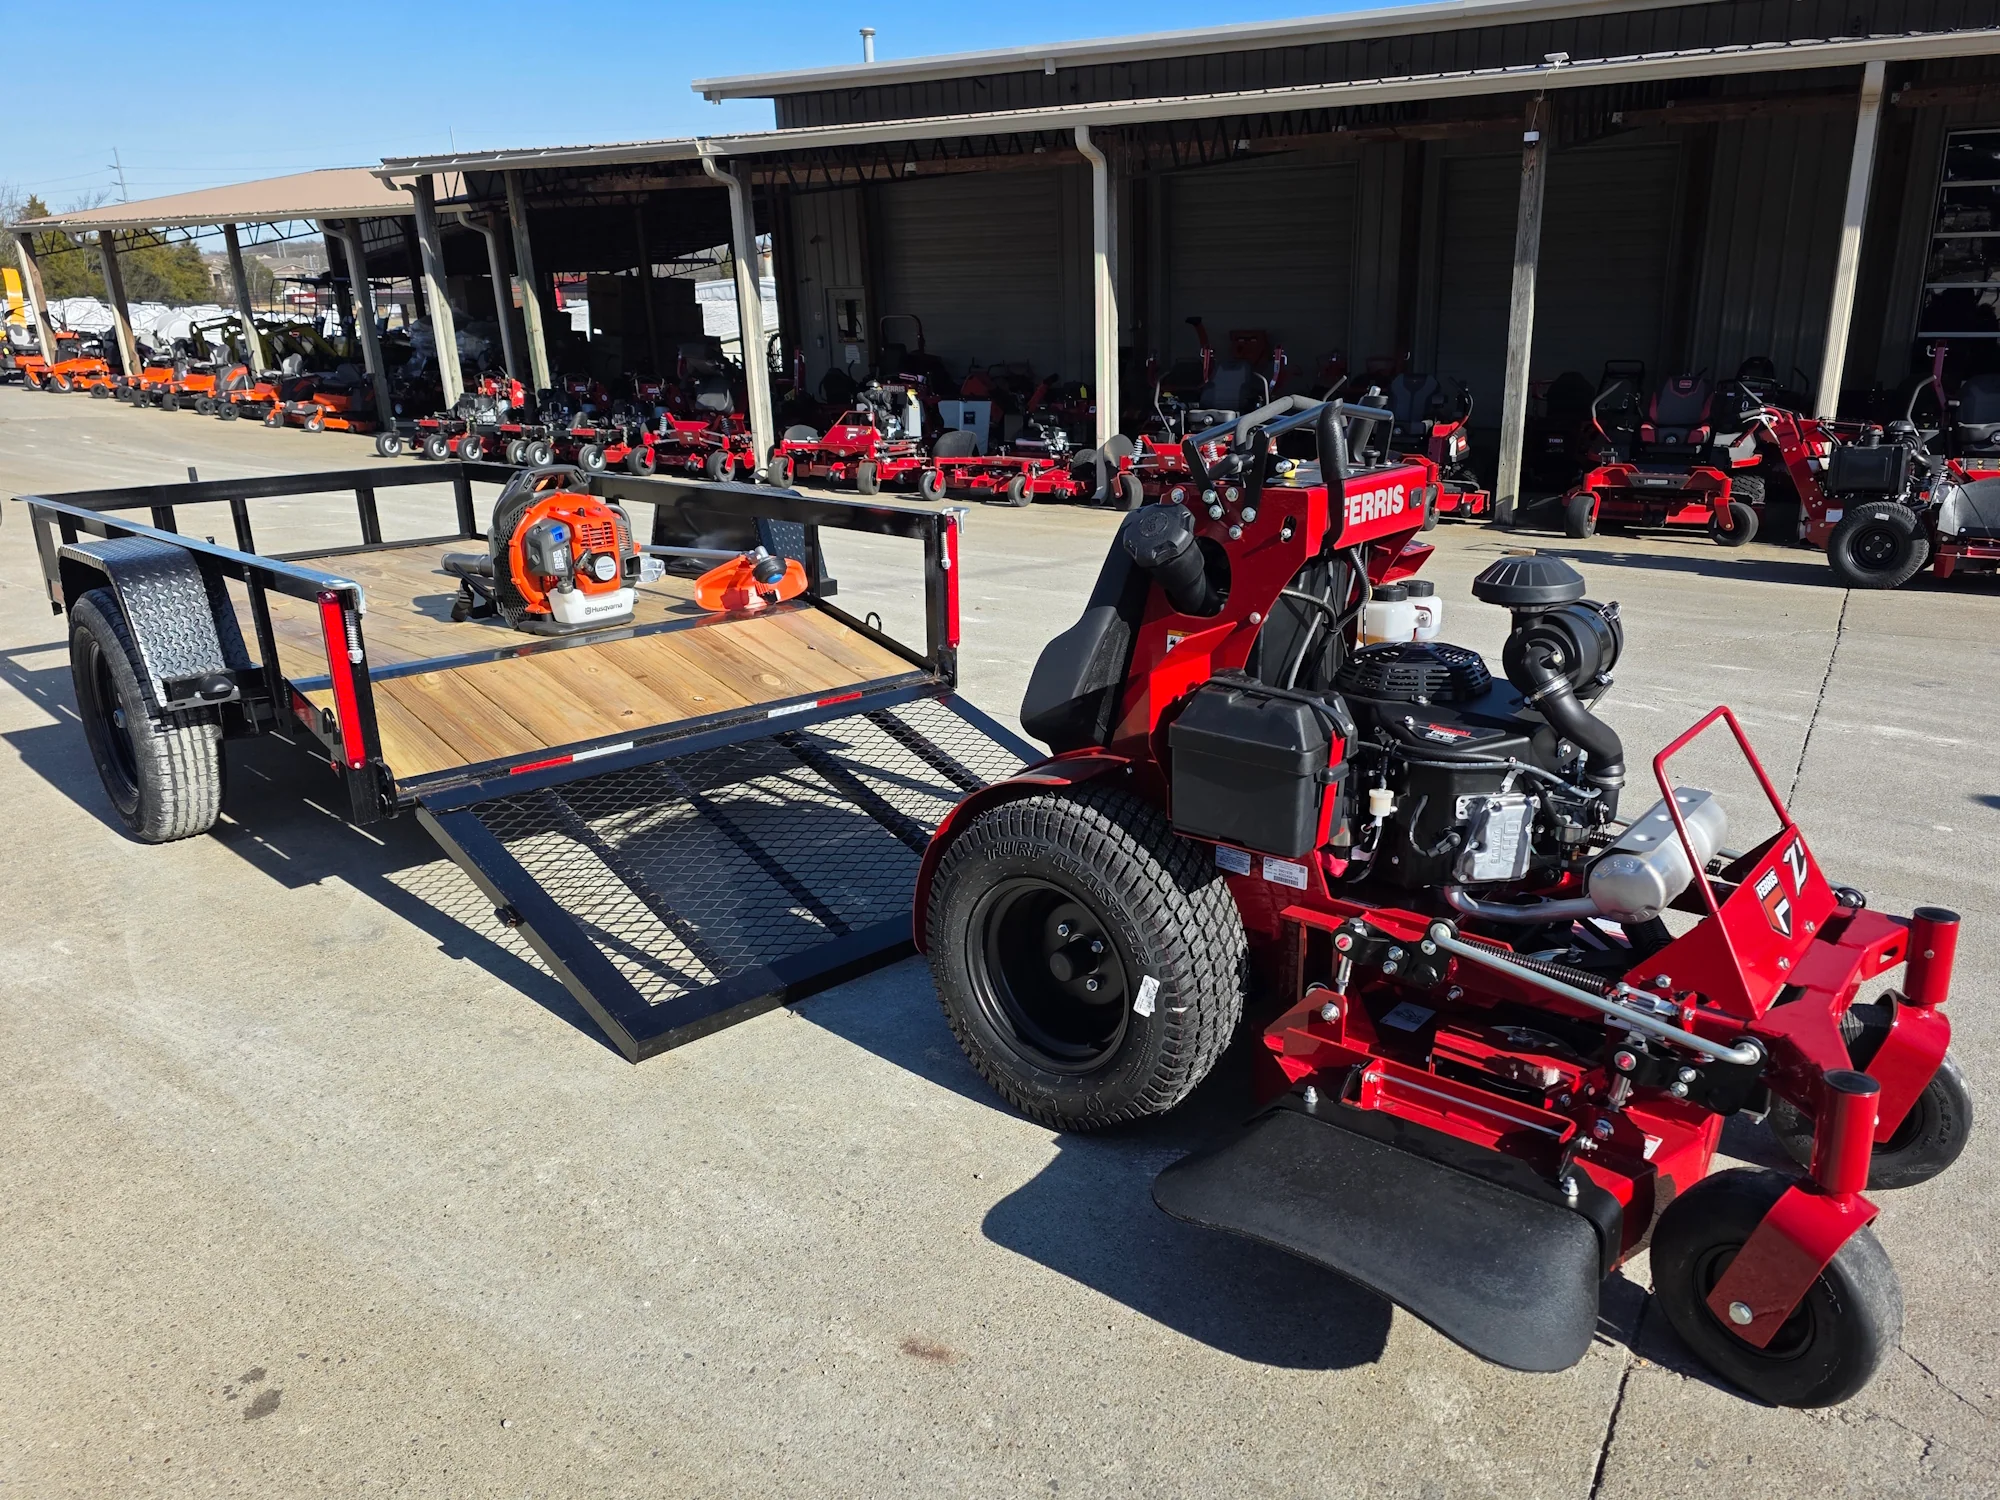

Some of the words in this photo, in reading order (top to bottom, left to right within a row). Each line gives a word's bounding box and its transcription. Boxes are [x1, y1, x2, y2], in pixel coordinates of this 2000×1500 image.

[592, 603, 623, 612] Husqvarna
[1754, 870, 1780, 901] FERRIS
[984, 841, 1051, 861] TURF
[1053, 852, 1151, 966] MASTER
